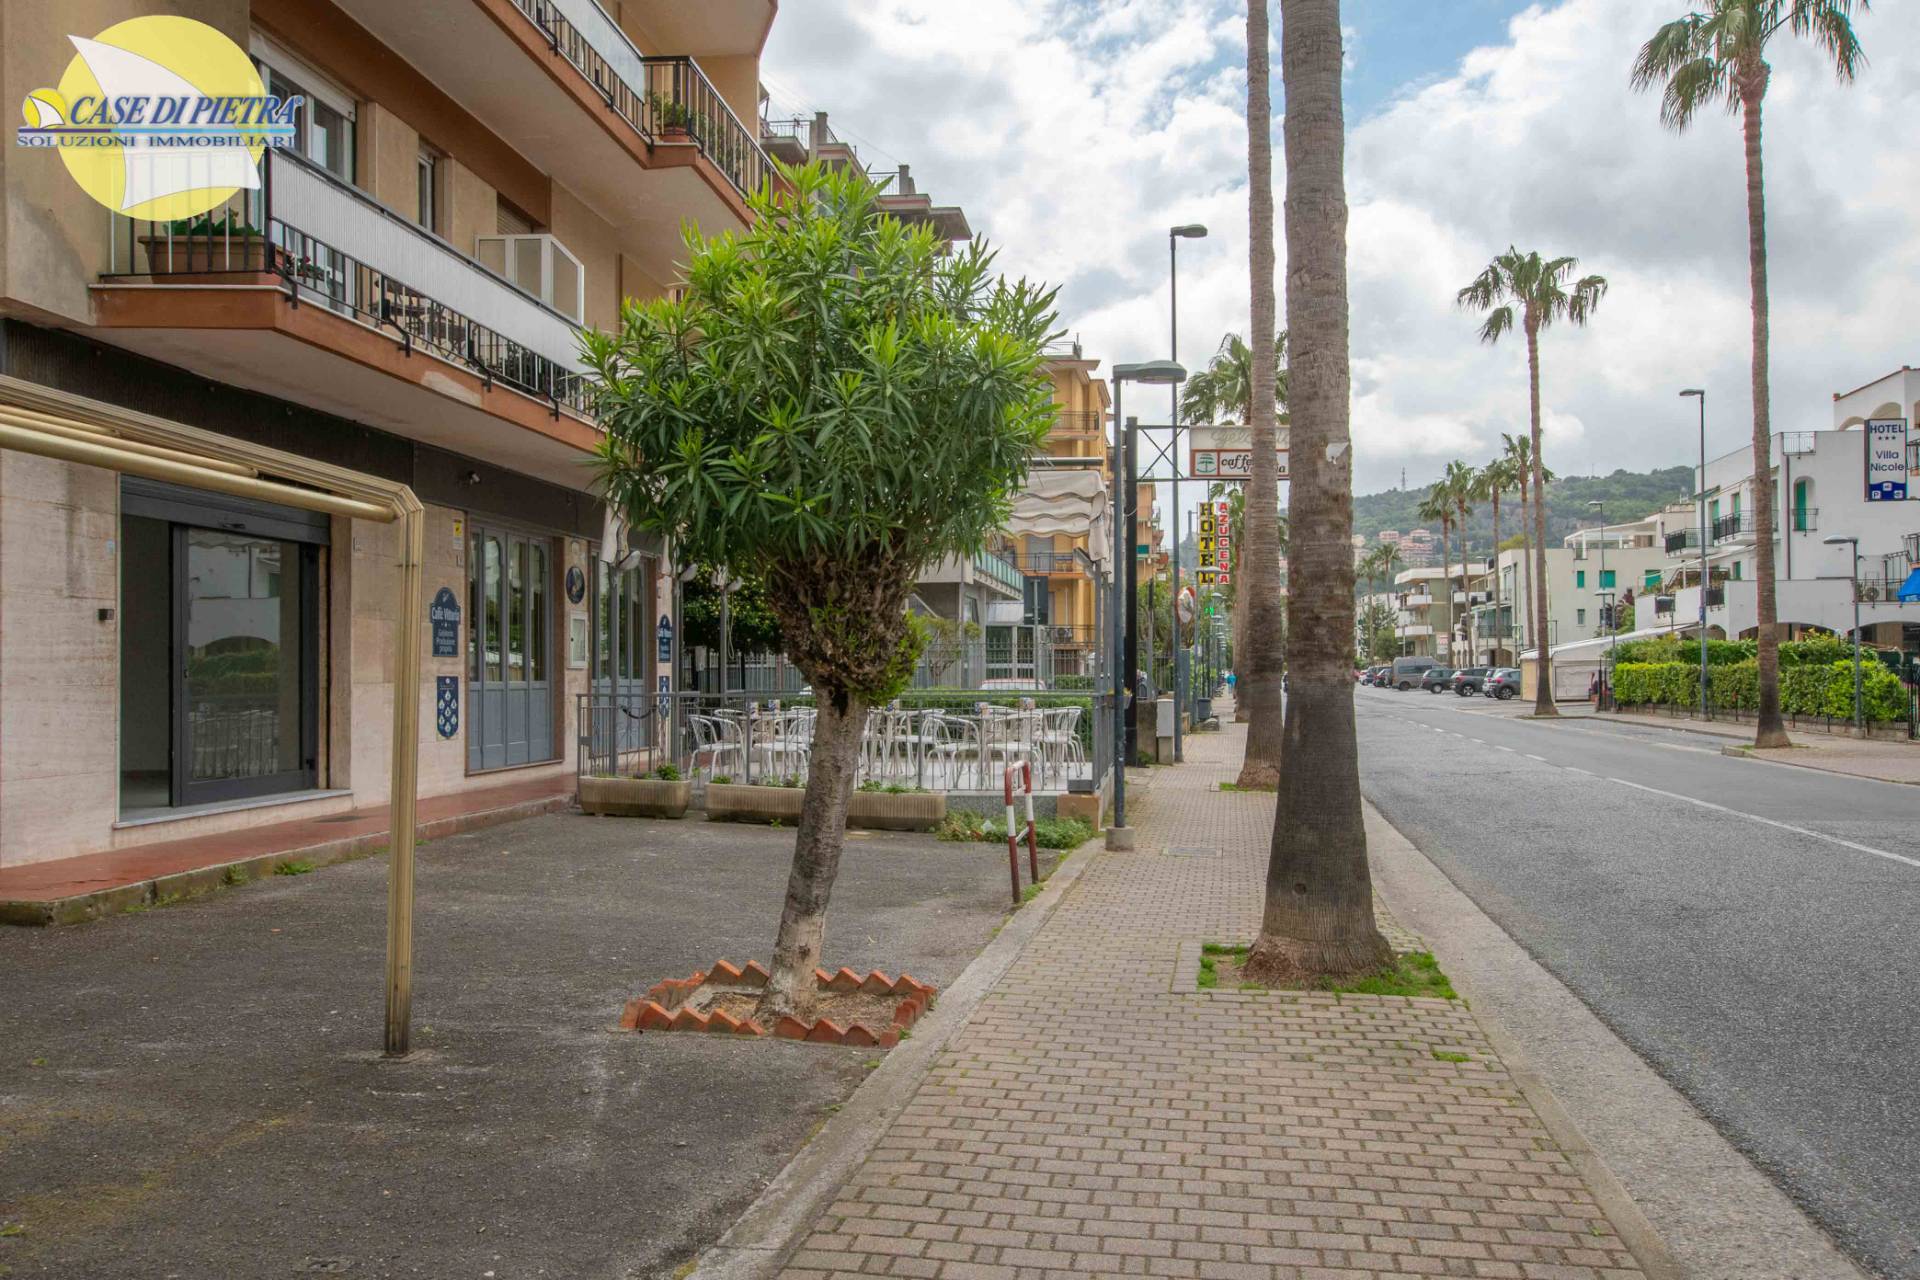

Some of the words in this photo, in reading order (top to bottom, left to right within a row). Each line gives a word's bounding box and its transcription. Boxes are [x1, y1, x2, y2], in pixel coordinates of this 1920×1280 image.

[1869, 424, 1904, 433] HOTEL
[1876, 450, 1899, 460] Villa
[1870, 462, 1904, 471] Nicole
[1201, 502, 1214, 584] HOTEL
[1218, 502, 1230, 584] AZUCENA
